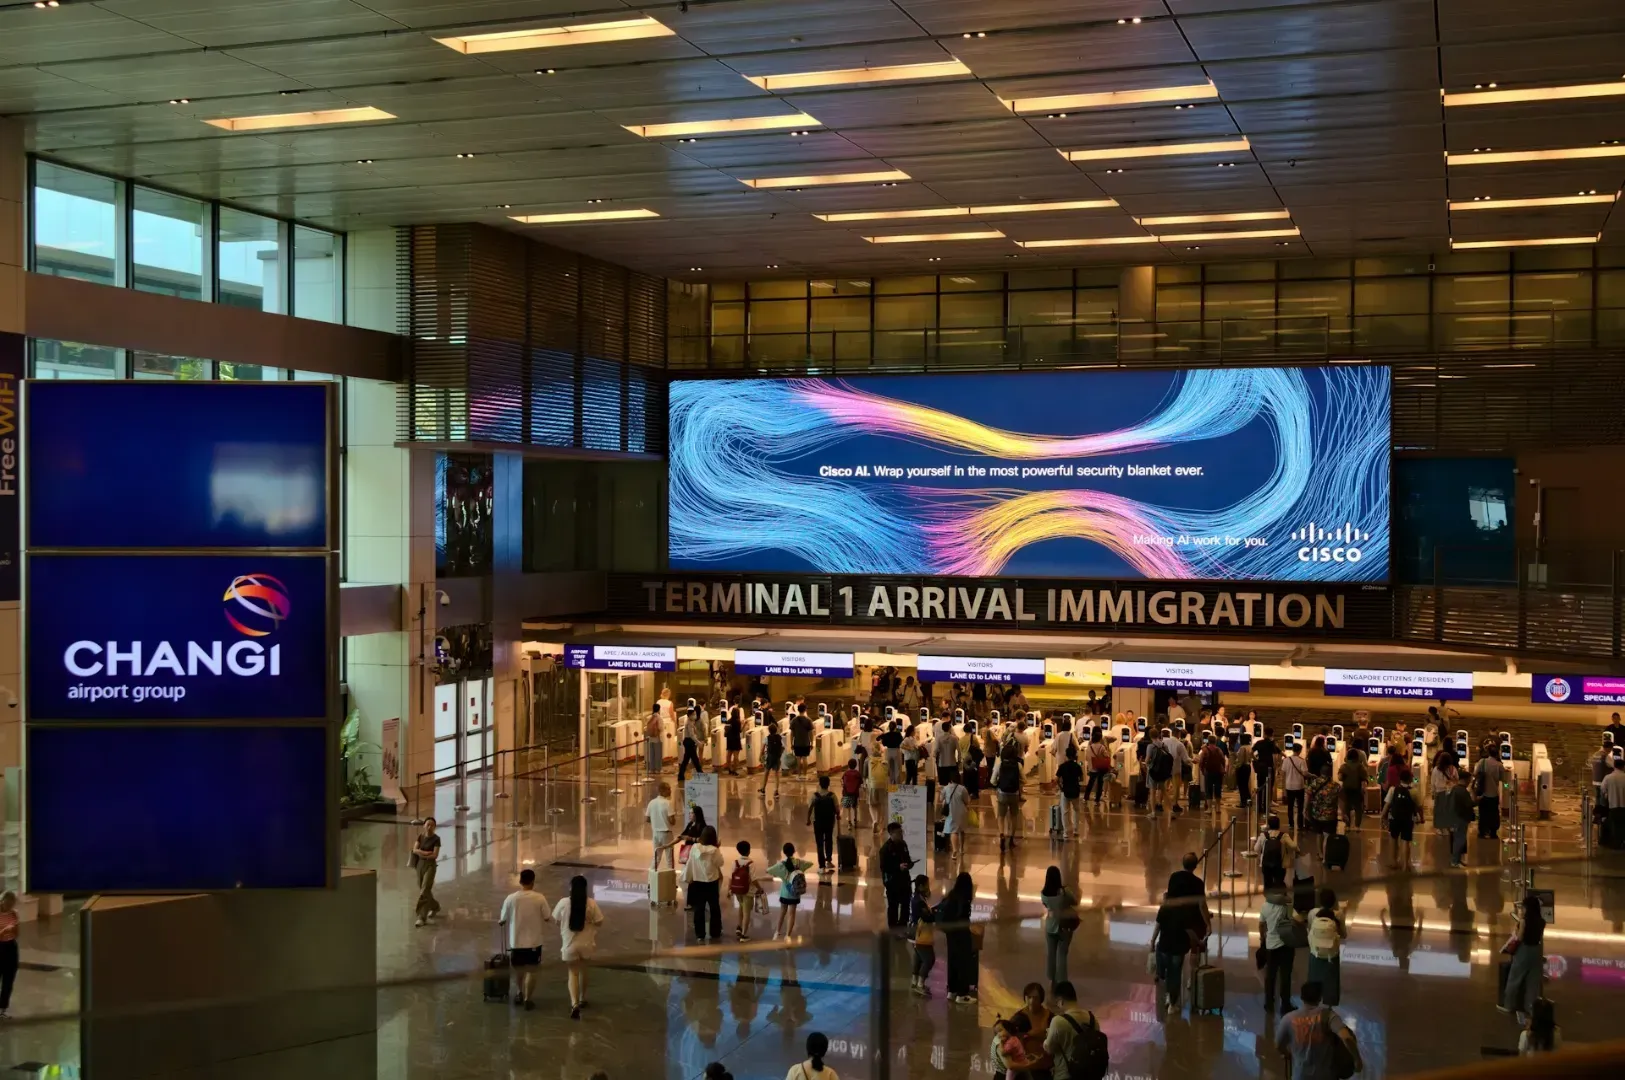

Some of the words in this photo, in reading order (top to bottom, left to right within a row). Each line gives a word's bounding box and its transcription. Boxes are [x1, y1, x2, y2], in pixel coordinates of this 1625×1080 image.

[0, 437, 15, 496] Free
[819, 465, 852, 477] Cisco
[855, 466, 870, 477] AI.
[874, 466, 904, 478] Wrap
[907, 465, 951, 478] yourself
[954, 466, 964, 476] in
[967, 465, 986, 477] the
[989, 466, 1019, 477] most
[1022, 465, 1073, 478] powerful
[1077, 465, 1123, 478] security
[1127, 464, 1171, 476] blanket
[1174, 467, 1204, 476] ever.
[1133, 534, 1174, 547] Making
[1177, 535, 1191, 545] AI
[1192, 535, 1221, 546] work
[1225, 535, 1241, 546] for
[1244, 537, 1268, 547] you.
[643, 581, 830, 617] TERMINAL
[838, 585, 854, 617] 1
[866, 584, 1036, 622] ARRIVAL
[1047, 588, 1345, 629] IMMIGRATION
[63, 640, 280, 677] CHANGI
[67, 683, 129, 702] airport
[132, 686, 186, 702] group
[1584, 694, 1616, 702] SPECIAL
